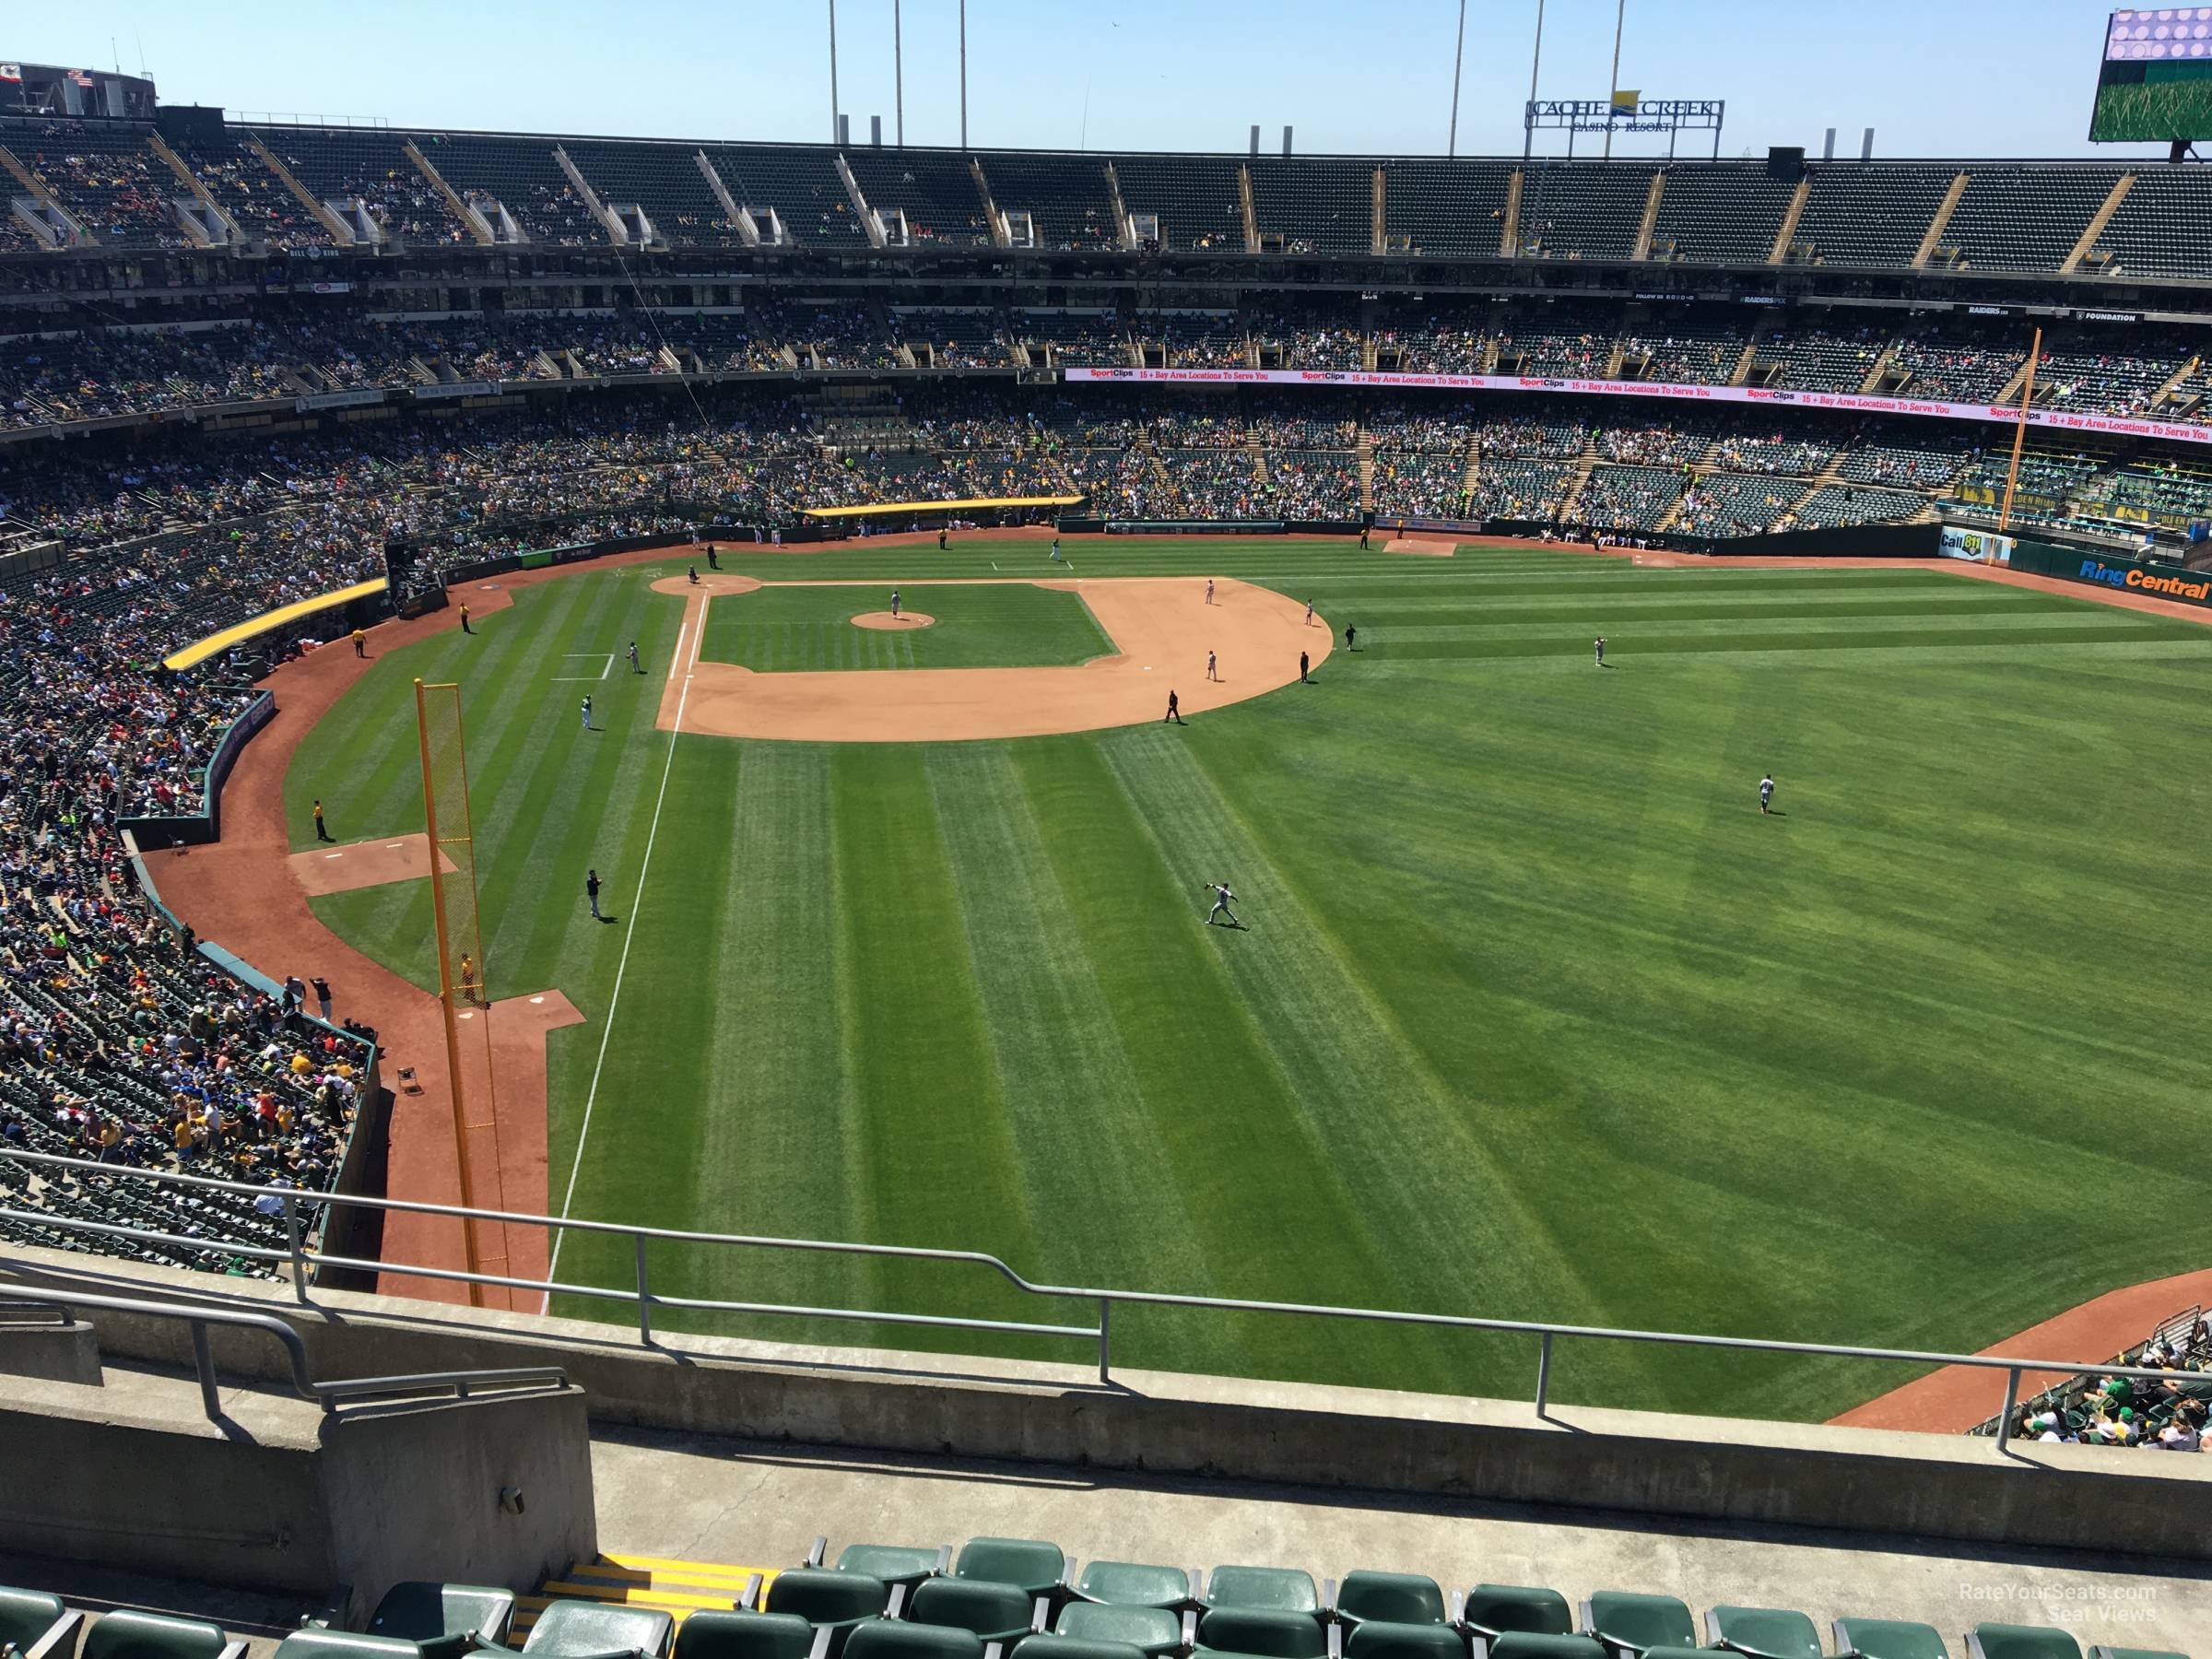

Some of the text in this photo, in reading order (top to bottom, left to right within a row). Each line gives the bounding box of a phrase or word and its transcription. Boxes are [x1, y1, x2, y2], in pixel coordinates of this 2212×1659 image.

[1533, 100, 1713, 116] CACHE CREEK
[1572, 122, 1672, 133] CASINO RESORT
[2085, 312, 2136, 323] FOUNDATION
[1090, 369, 1133, 378] SportClips
[1155, 371, 1169, 380] Bay
[1171, 371, 1187, 379] Area
[1188, 371, 1221, 380] Locations
[1223, 371, 1232, 380] To
[1233, 371, 1253, 380] Serve
[1255, 371, 1268, 380] You
[1301, 371, 1346, 381] SportClips
[1351, 374, 1359, 382] 15
[1368, 375, 1382, 384] Bay
[1382, 375, 1400, 383] Area
[1402, 375, 1436, 384] Locations
[1437, 376, 1447, 385] To
[1448, 377, 1469, 385] Serve
[1470, 377, 1485, 386] You
[1519, 378, 1564, 388] SportClips
[1571, 382, 1580, 390] 15
[1588, 382, 1602, 393] Bay
[1604, 383, 1622, 392] Area
[1624, 384, 1659, 394] Locations
[1661, 386, 1671, 394] To
[1672, 387, 1694, 395] Serve
[1696, 388, 1711, 397] You
[1747, 389, 1794, 400] SportClips
[1802, 394, 1811, 403] 15
[1819, 395, 1834, 406] Bay
[1837, 397, 1855, 406] Area
[1858, 398, 1896, 409] Locations
[1898, 402, 1908, 410] To
[1909, 403, 1933, 412] Serve
[1935, 405, 1950, 414] You
[1990, 406, 2041, 420] SportCips
[2049, 415, 2059, 424] 15
[2067, 417, 2084, 428] Bay
[2086, 418, 2106, 429] Area
[2108, 420, 2149, 434] Locations
[2152, 424, 2163, 434] To
[2165, 426, 2190, 438] Serve
[2192, 429, 2208, 440] You
[1940, 534, 1982, 549] Call 811
[2079, 559, 2210, 600] RingCentral
